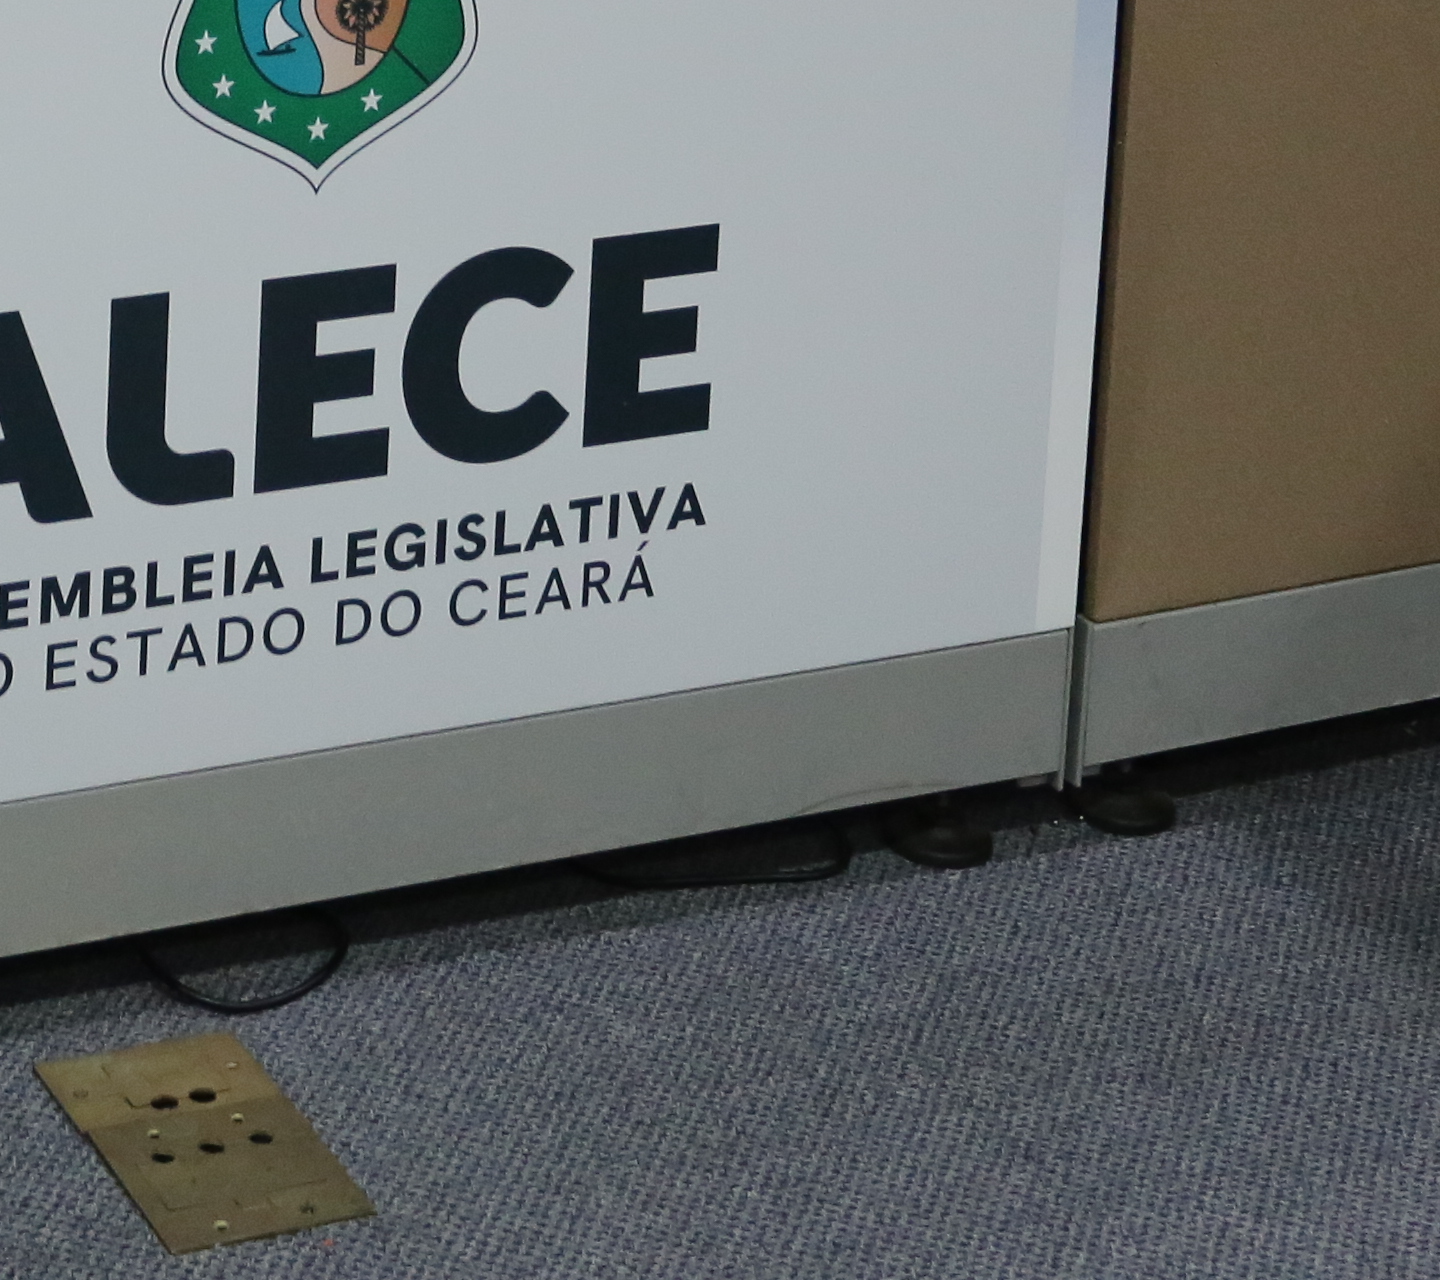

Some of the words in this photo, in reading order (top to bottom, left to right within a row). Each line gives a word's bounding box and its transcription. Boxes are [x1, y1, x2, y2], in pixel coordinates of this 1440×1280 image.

[310, 483, 707, 584] LEGISLATIVA
[44, 608, 306, 692] ESTADO
[335, 590, 422, 646] DO
[449, 542, 655, 625] CEARÁ
